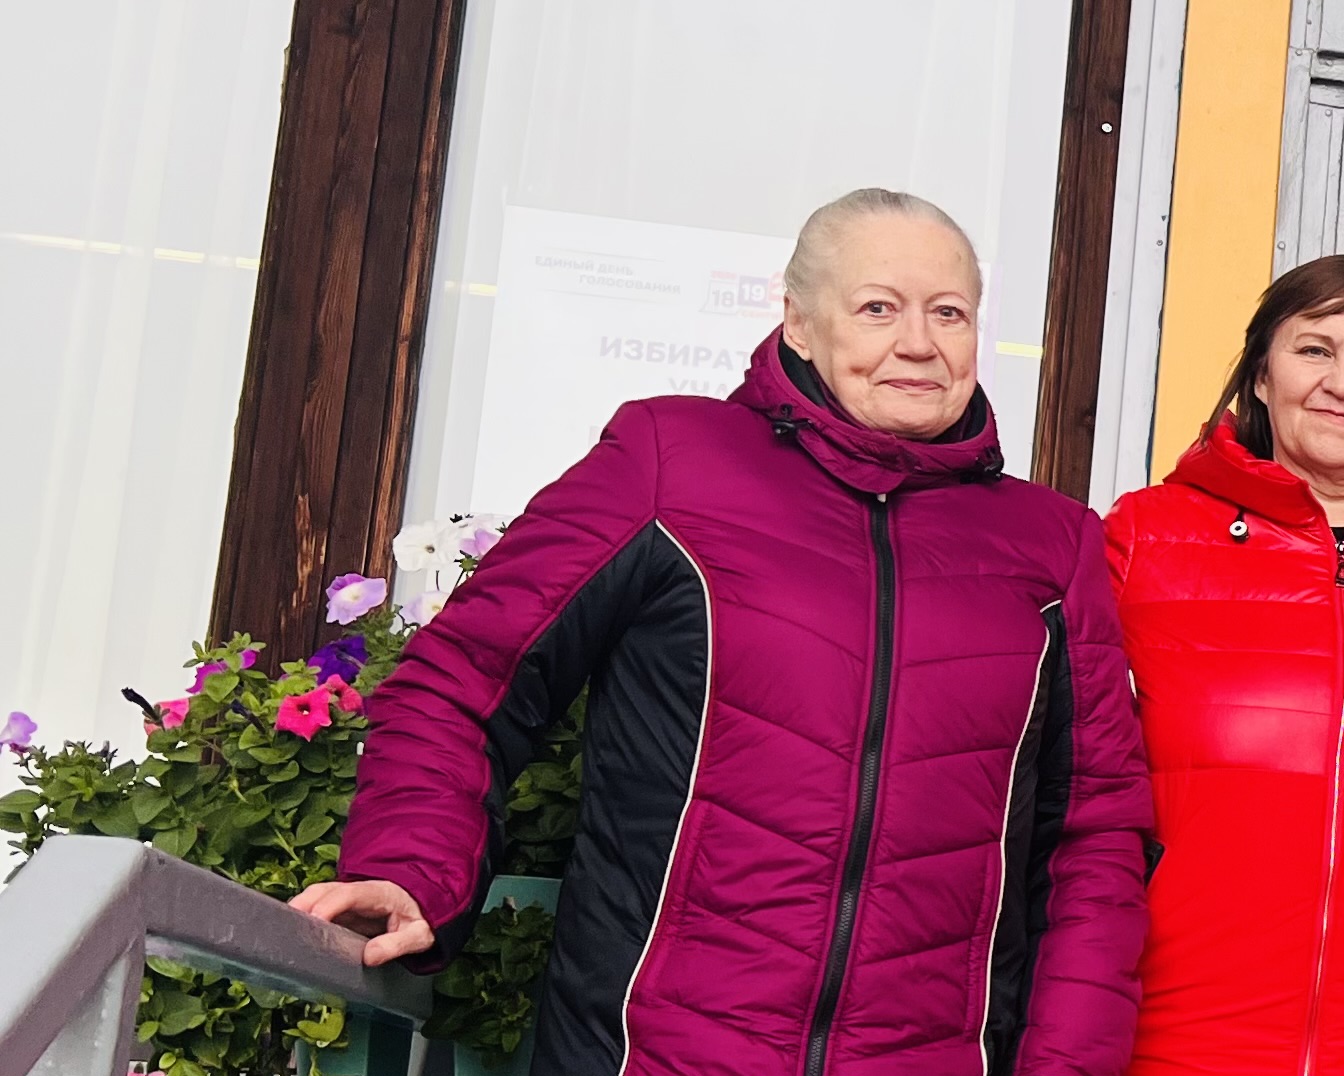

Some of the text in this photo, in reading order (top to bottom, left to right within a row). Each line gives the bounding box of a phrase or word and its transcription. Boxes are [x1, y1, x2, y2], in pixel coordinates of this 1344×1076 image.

[534, 255, 635, 277] ЕДИНЫЙ ДЕНЬ
[578, 273, 681, 295] ГОЛОСОВАНИЯ
[740, 283, 767, 301] 19
[712, 288, 736, 308] 18
[599, 335, 750, 372] ИЗБИРАТ
